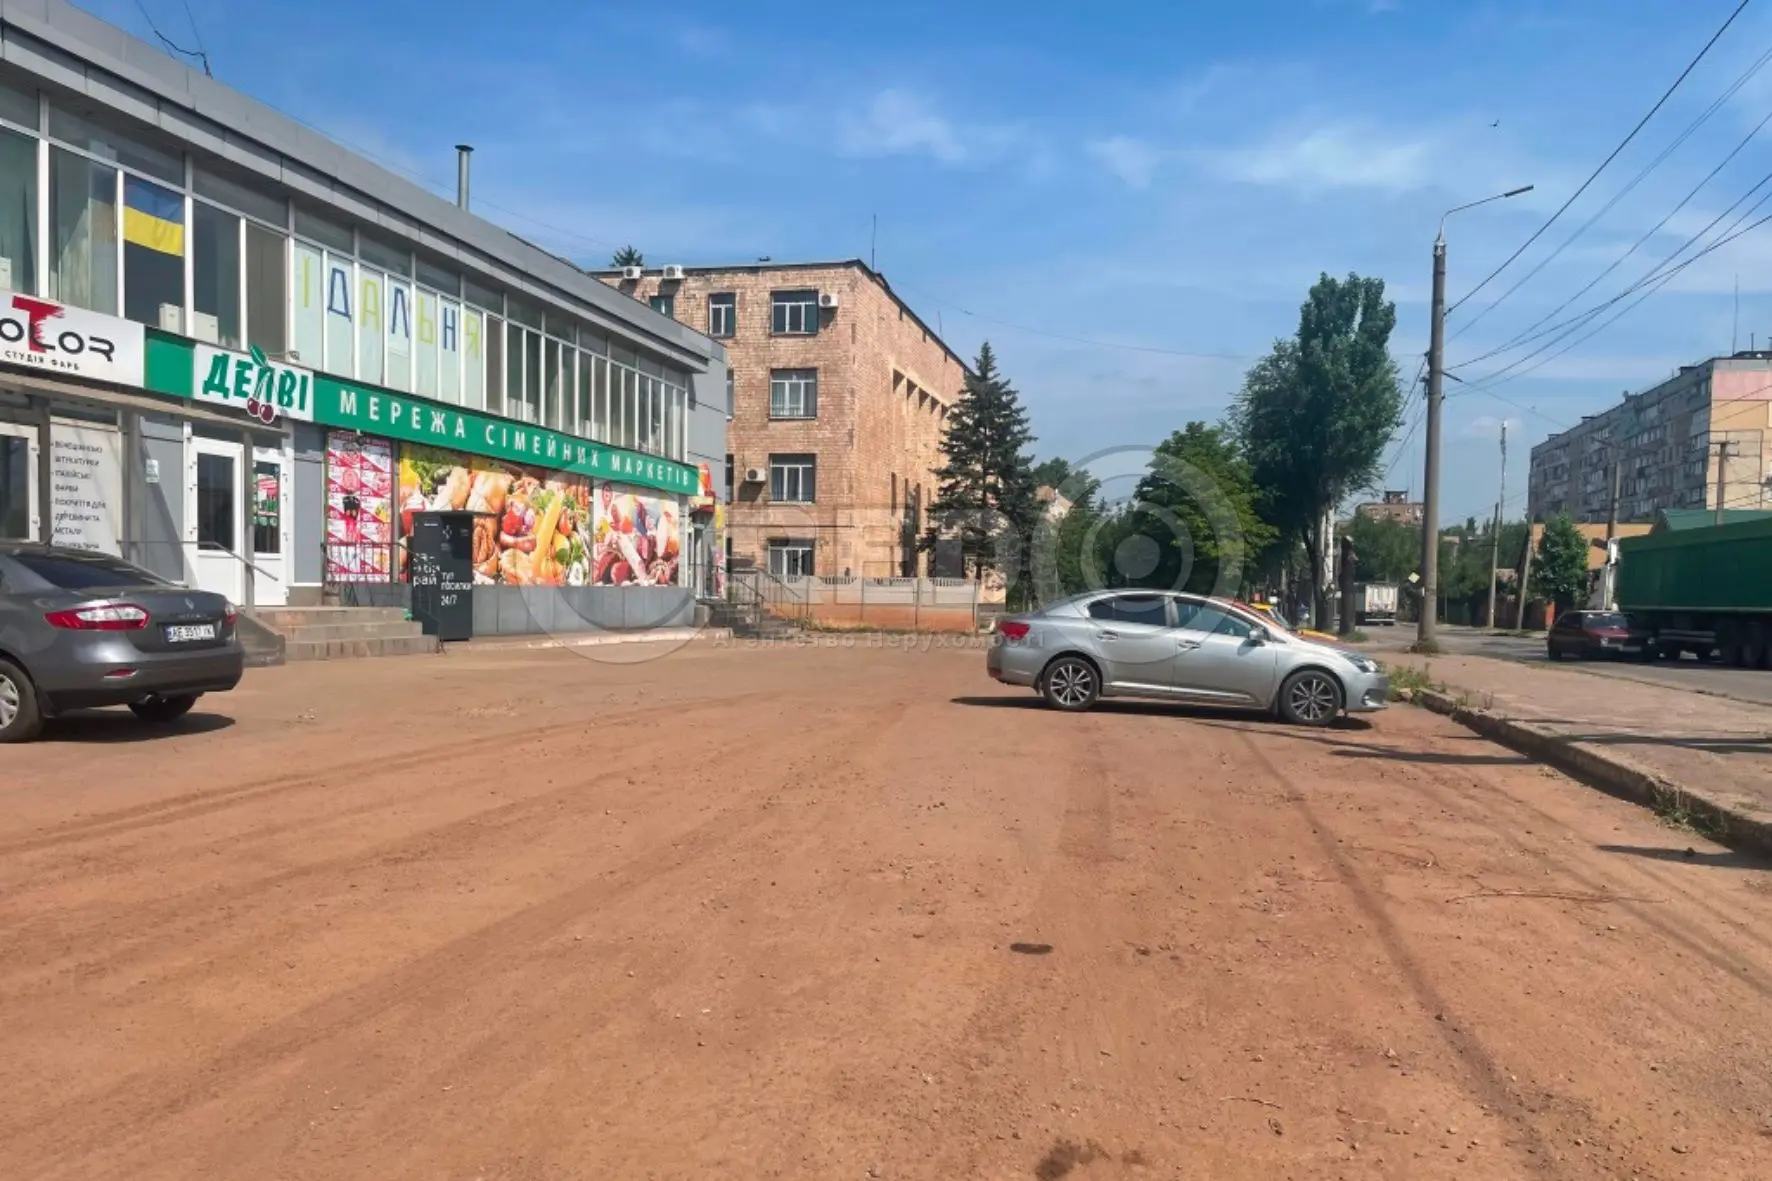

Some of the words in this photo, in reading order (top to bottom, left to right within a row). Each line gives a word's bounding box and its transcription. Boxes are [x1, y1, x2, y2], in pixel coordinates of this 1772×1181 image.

[202, 353, 309, 412] ДЕЛВІ
[340, 389, 467, 438] МЕРЕЖА
[485, 424, 600, 468] СІМЕЙНИХ
[611, 454, 690, 487] МАРКЕТІВ
[441, 594, 458, 606] 24/7
